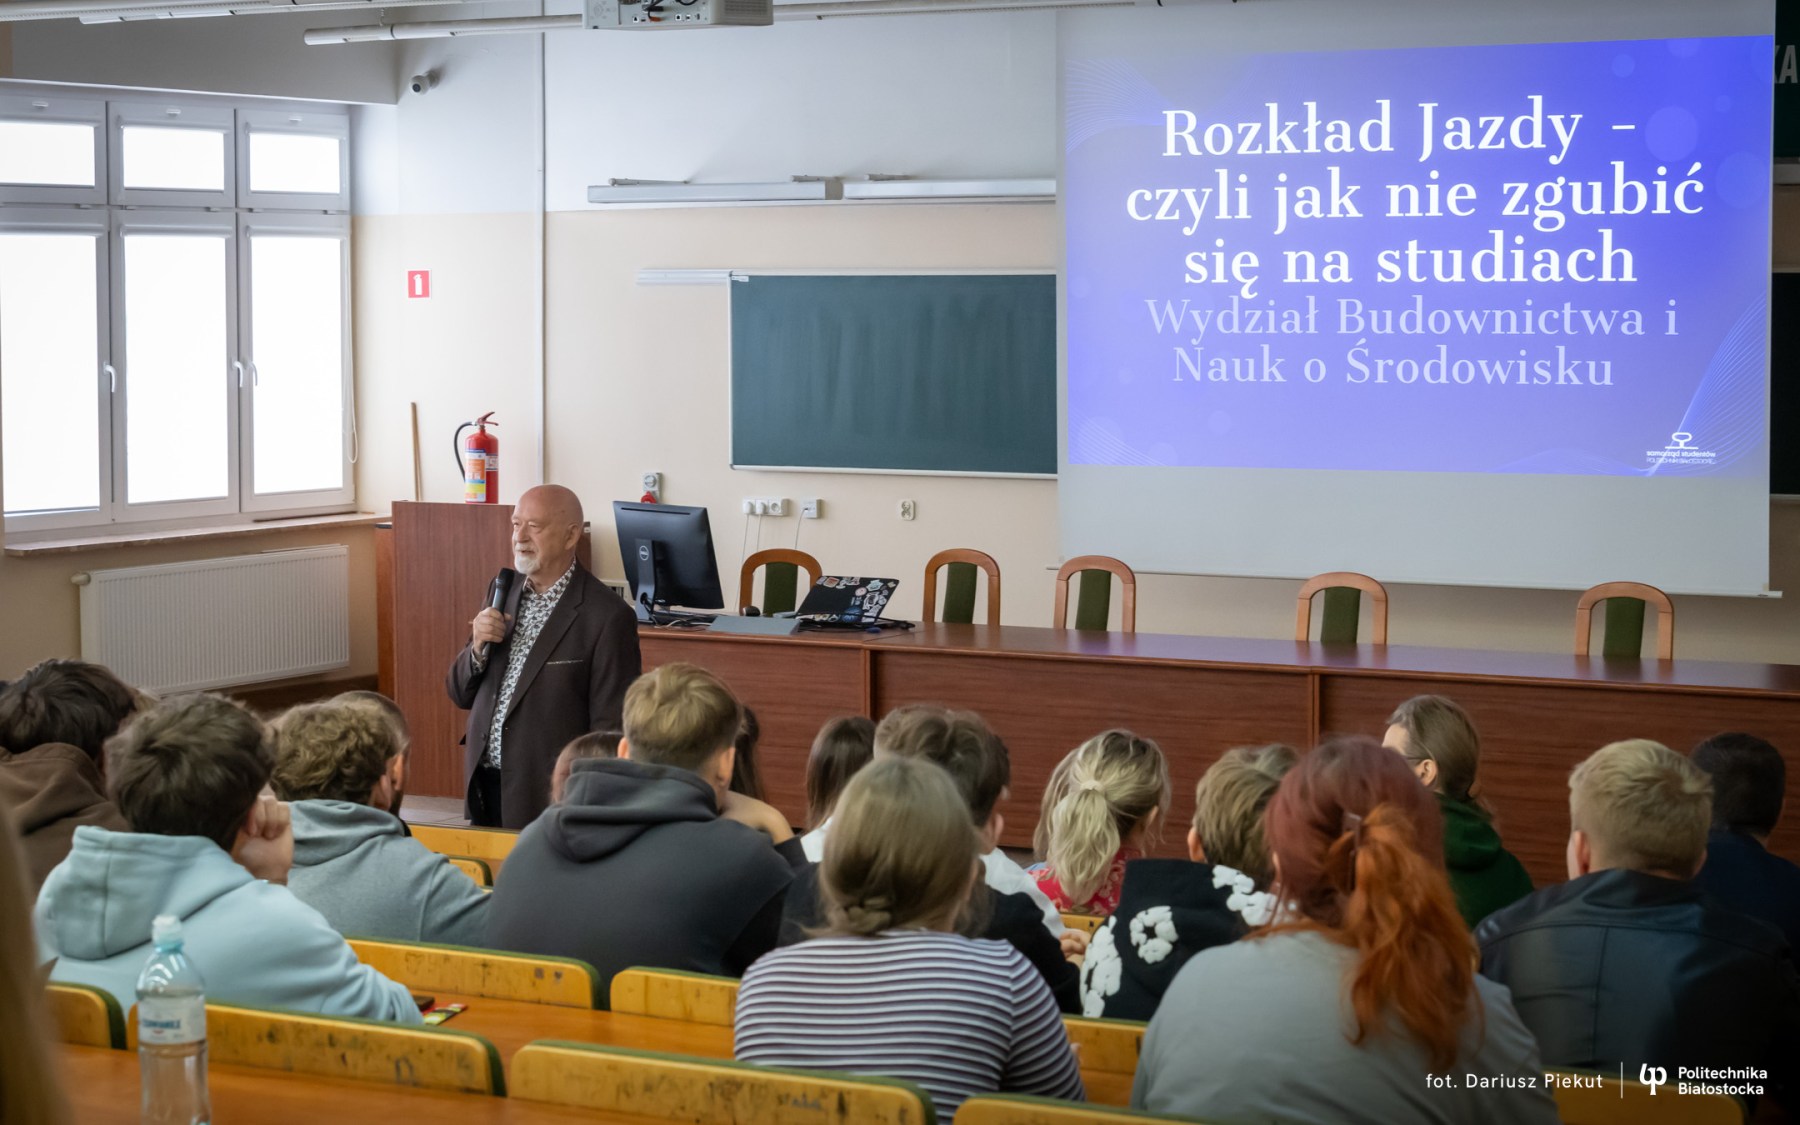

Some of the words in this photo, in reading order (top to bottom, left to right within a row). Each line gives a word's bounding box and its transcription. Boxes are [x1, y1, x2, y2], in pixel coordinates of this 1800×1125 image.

[1162, 99, 1394, 157] Rozkład
[1418, 95, 1583, 164] Jazdy
[1126, 168, 1252, 235] czyli
[1273, 166, 1364, 235] jak
[1385, 169, 1477, 217] nie
[1501, 161, 1704, 231] zgubić
[1184, 238, 1260, 298] się
[1283, 250, 1353, 283] na
[1376, 230, 1638, 283] studiach
[1144, 296, 1319, 344] Wydział
[1336, 294, 1645, 336] Budownictwa
[1664, 299, 1679, 336] i
[1172, 344, 1287, 383] Nauk
[1303, 358, 1327, 383] o
[1346, 338, 1614, 386] Środowisku
